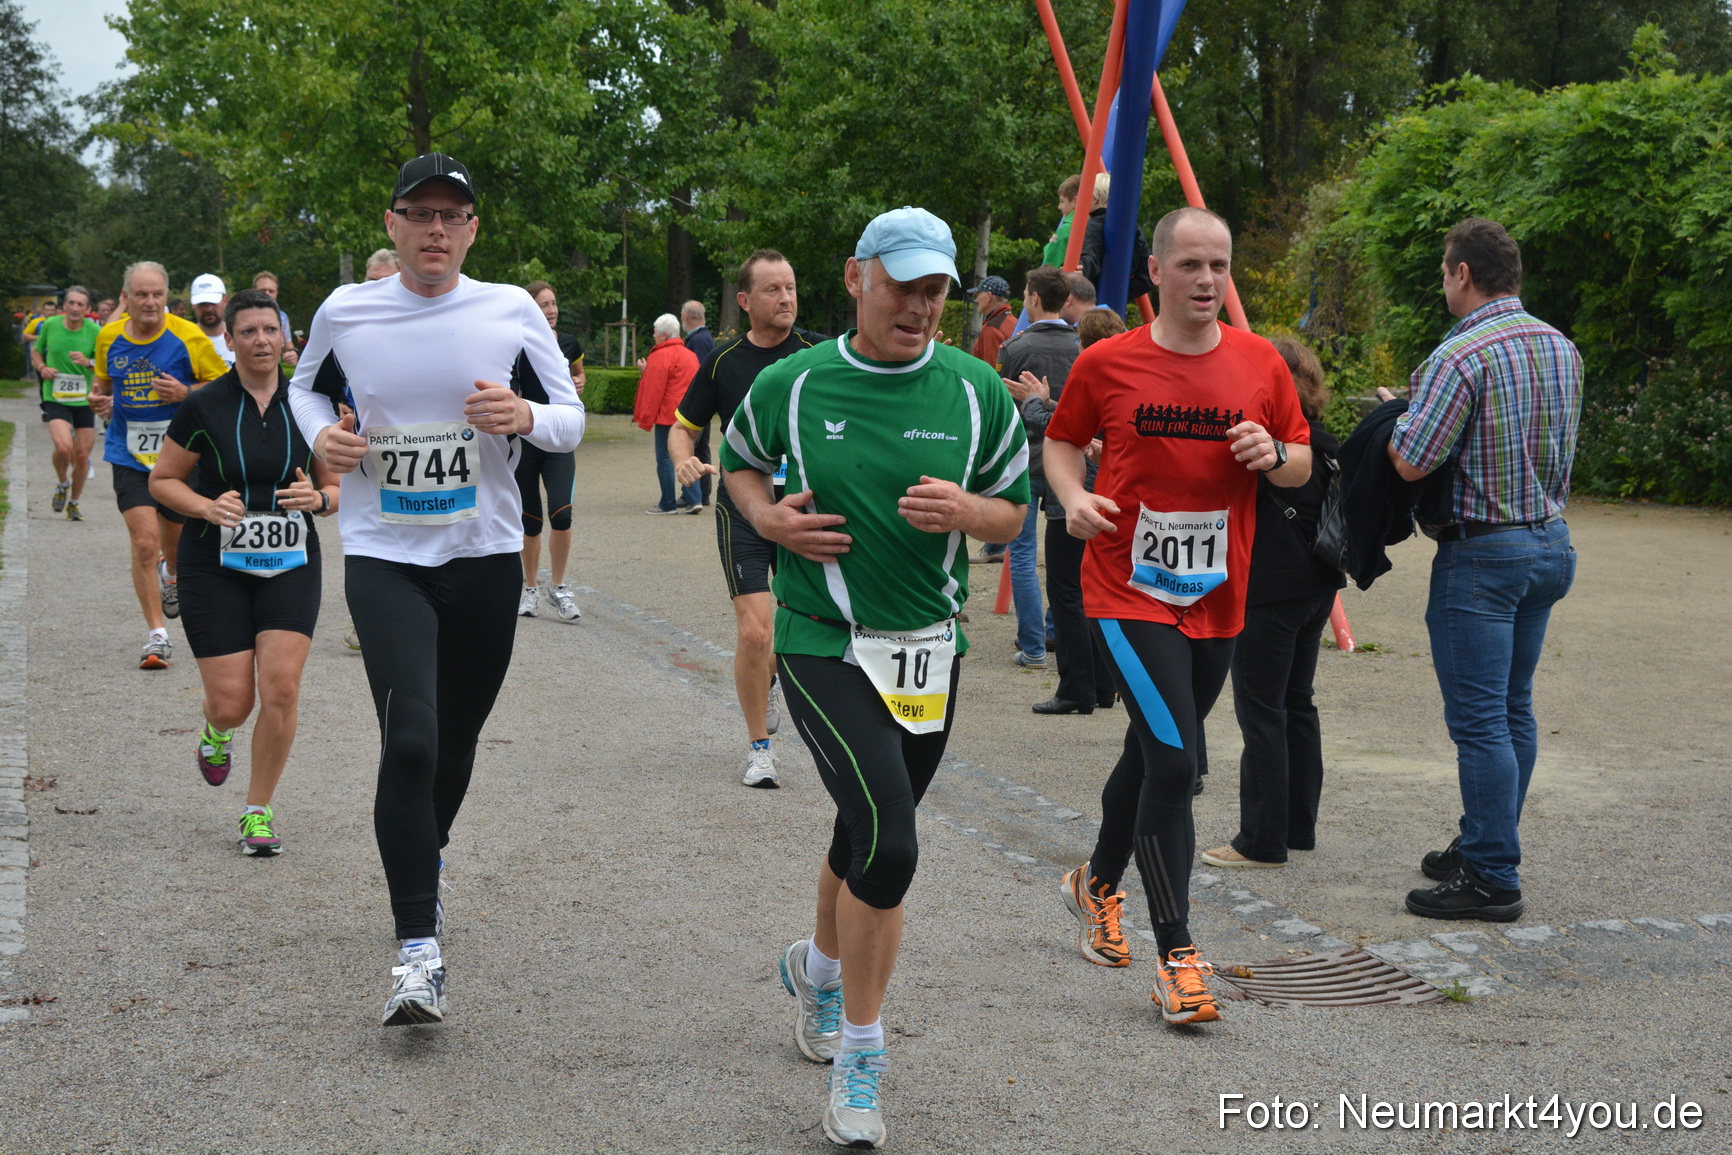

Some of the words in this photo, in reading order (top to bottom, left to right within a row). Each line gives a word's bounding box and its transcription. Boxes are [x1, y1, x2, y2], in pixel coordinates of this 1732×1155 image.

[60, 381, 80, 391] 281
[903, 428, 943, 440] africon
[1140, 420, 1165, 432] RUN
[1167, 421, 1189, 433] FOR
[369, 436, 401, 446] PARTL
[403, 431, 458, 445] Neumarkt
[381, 446, 470, 487] 2744
[397, 496, 455, 512] Thorsten
[1168, 521, 1213, 531] Neumarkt
[231, 520, 299, 549] 2380
[1143, 530, 1216, 570] 2011
[245, 556, 283, 567] Kerstin
[1155, 572, 1204, 593] Andreas
[891, 647, 931, 689] 10
